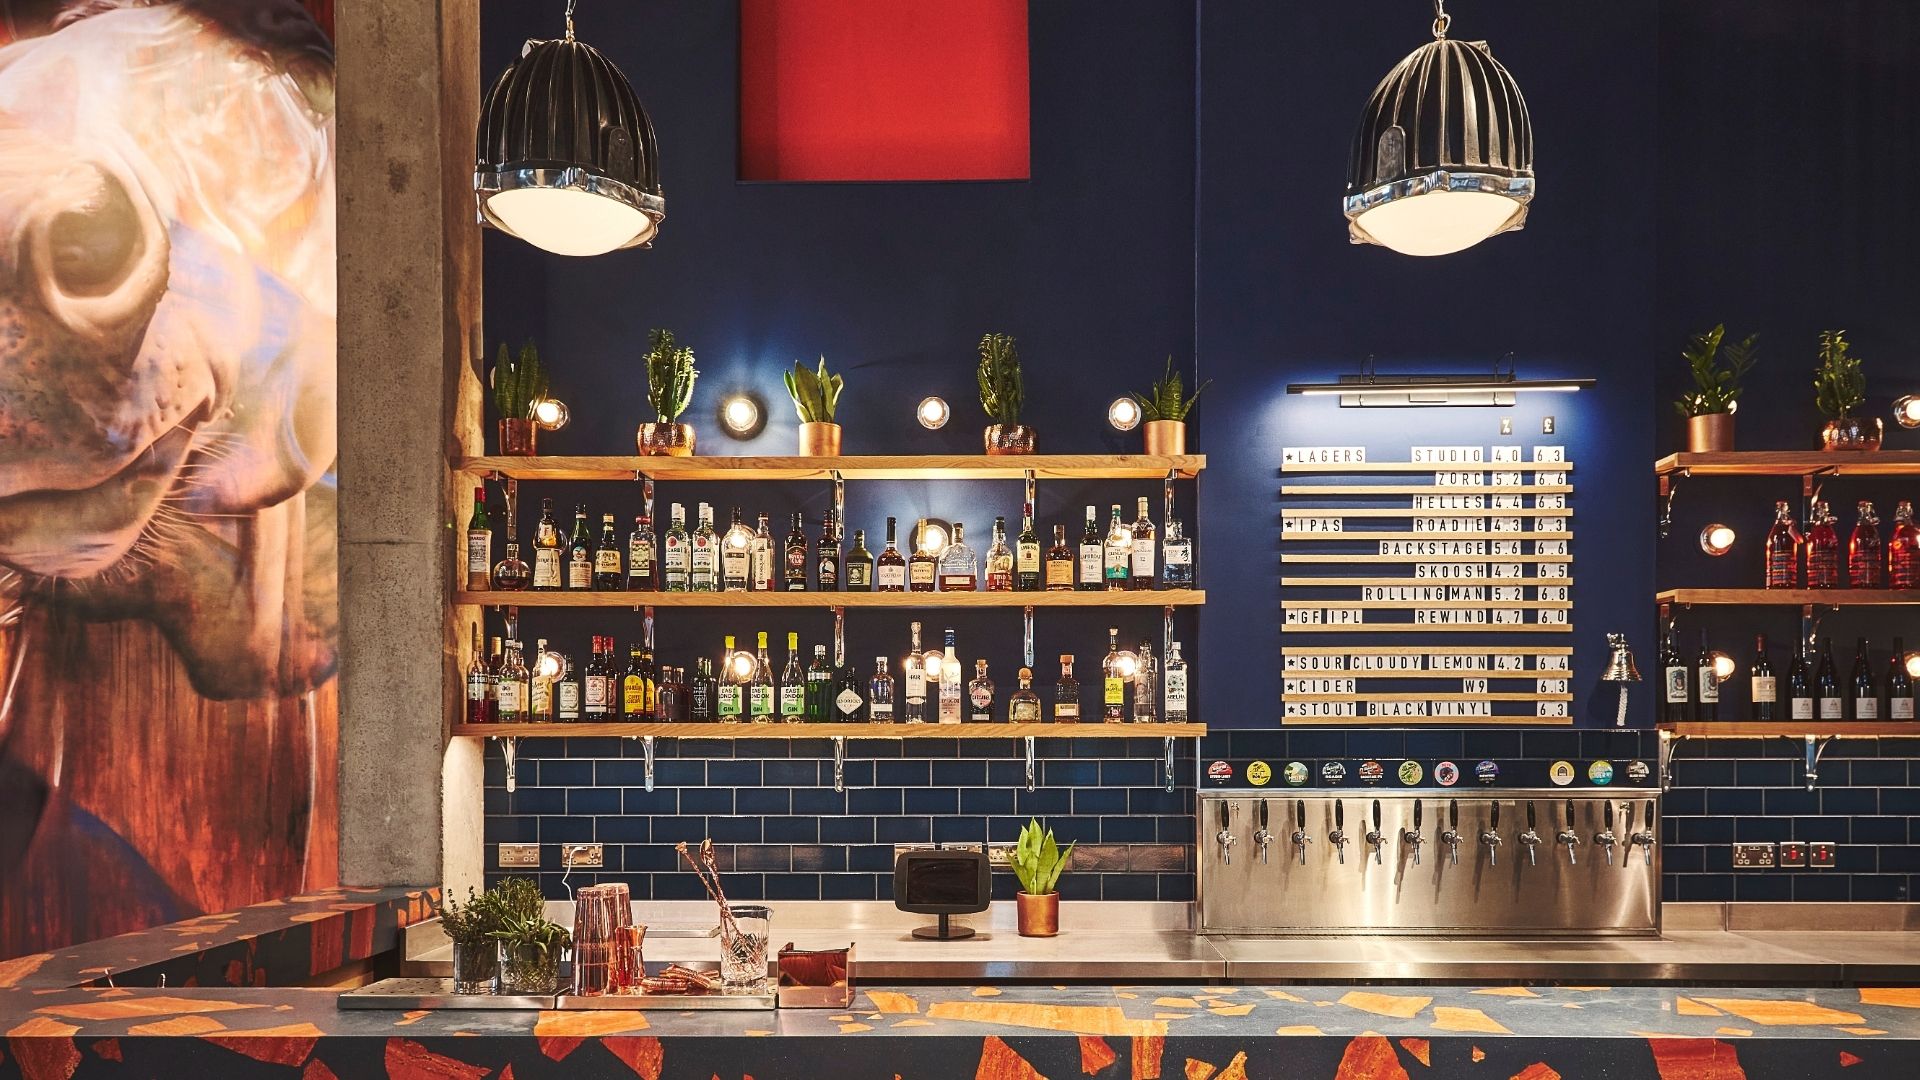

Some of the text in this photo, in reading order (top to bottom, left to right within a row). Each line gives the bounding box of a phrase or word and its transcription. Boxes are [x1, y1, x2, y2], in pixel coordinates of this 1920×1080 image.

[1502, 420, 1553, 433] % £
[1298, 450, 1560, 462] LAGERS STUDIO 4.0 6.3
[1439, 473, 1563, 485] ZORC 5.2 6.6
[1416, 496, 1562, 508] HELLES 4.4 6.5
[1300, 519, 1562, 532] IPAS ROADIE 4.3 6.3
[1383, 543, 1564, 555] BACKSTAGE 5.6 6.6
[1419, 566, 1565, 578] SKOOSH 4.2 6.5
[1366, 588, 1565, 601] ROLLING MAN 5.2 6.8
[1302, 610, 1564, 624] GF IPL REWIND 4.7 6.0
[1300, 657, 1565, 670] SOUR CLOUDY LEMON 4.2 6.4
[1300, 681, 1564, 693] CIDER W9 6.3
[1300, 703, 1563, 716] STOUT BLACK VINYL 6.3
